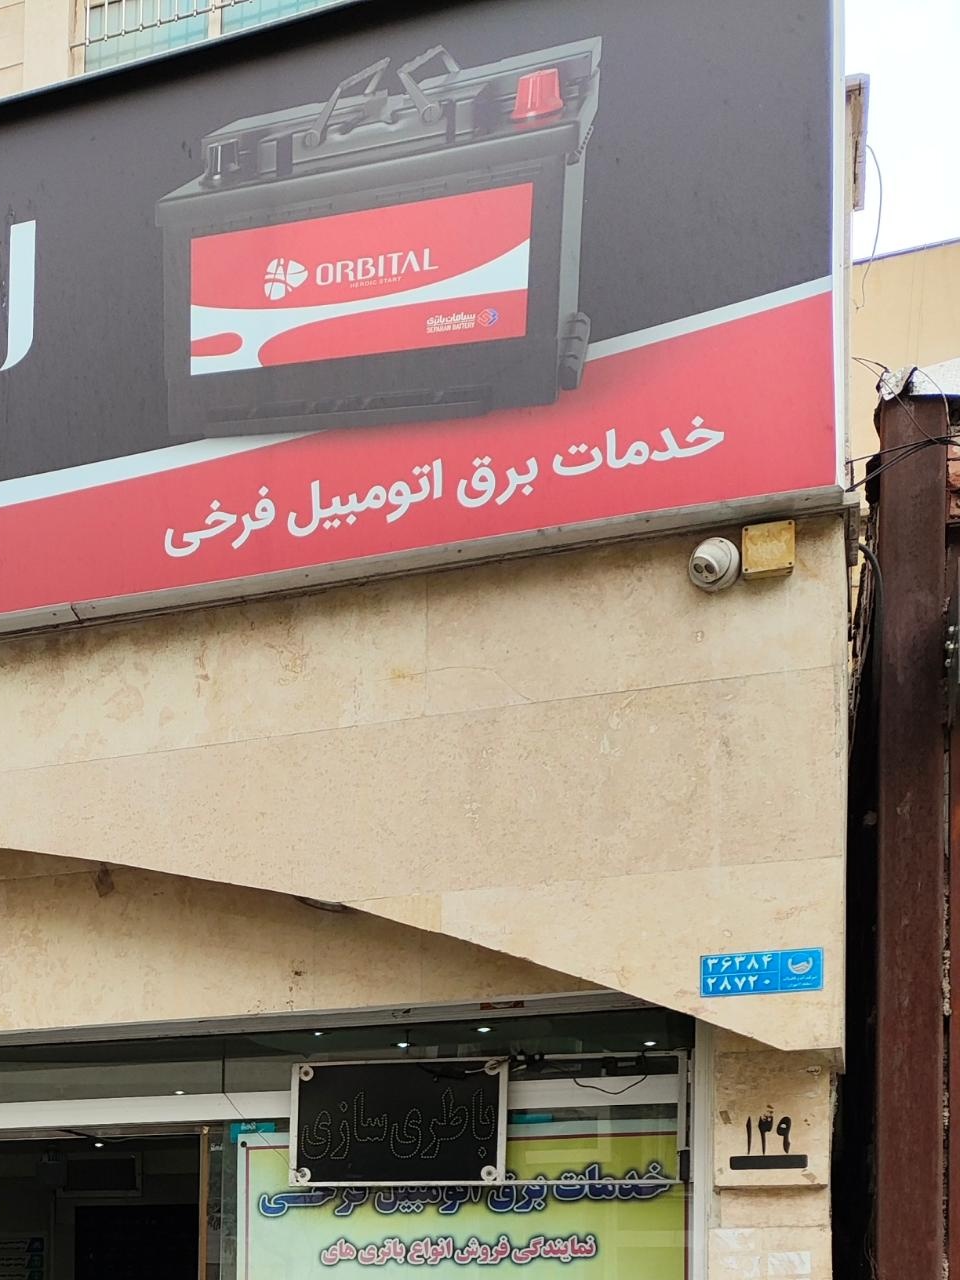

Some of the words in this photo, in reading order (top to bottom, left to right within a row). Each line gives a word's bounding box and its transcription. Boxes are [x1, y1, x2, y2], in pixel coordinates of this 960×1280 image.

[315, 248, 439, 286] ORBITAL
[379, 276, 402, 284] START
[551, 415, 726, 477] خدمات
[286, 458, 443, 537] اتومبیل
[456, 451, 538, 508] برق
[163, 485, 276, 558] فرخی
[301, 1090, 388, 1160] سازی
[390, 1087, 494, 1159] باطری
[746, 1114, 791, 1155] ۱۳۹
[487, 1171, 548, 1212] برق
[553, 1162, 672, 1200] خدمات
[320, 1238, 357, 1266] های
[358, 1238, 405, 1265] باتری
[406, 1237, 453, 1265] انواع
[454, 1233, 511, 1264] فروش
[511, 1234, 596, 1264] نمایندگی
